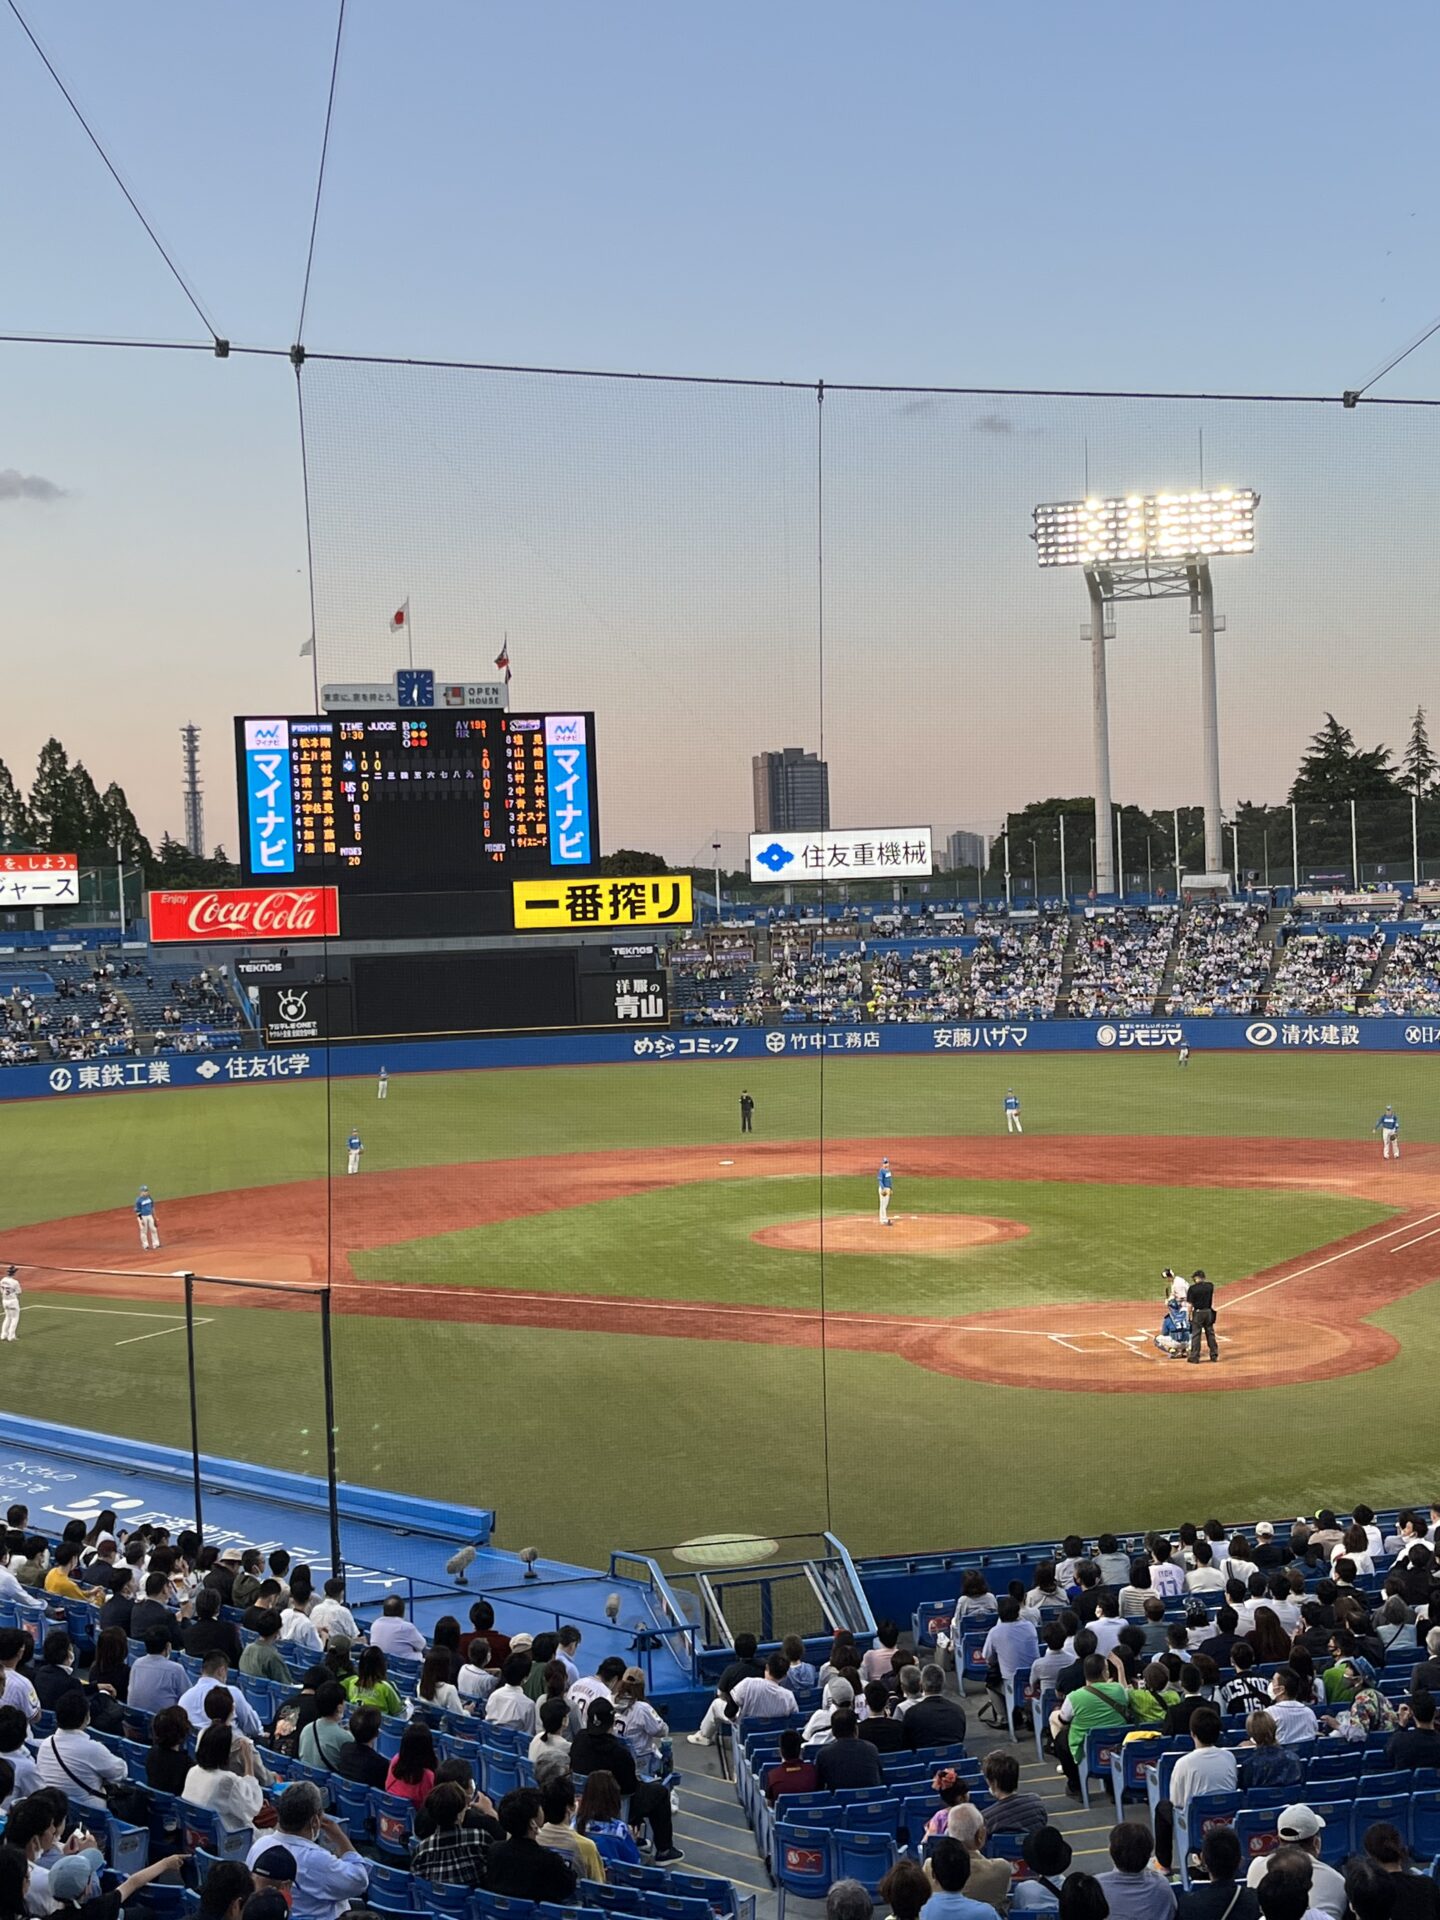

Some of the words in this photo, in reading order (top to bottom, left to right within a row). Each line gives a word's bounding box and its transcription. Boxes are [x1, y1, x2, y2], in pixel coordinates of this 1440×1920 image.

[468, 688, 499, 696] OPEN
[469, 697, 499, 705] HOUSE
[340, 722, 364, 731] TIME
[367, 722, 397, 731] JUDGE
[402, 721, 411, 730] B
[340, 731, 364, 740] 0:30
[403, 731, 411, 740] S
[253, 755, 287, 867] マイナビ
[553, 749, 585, 859] マイナビ
[516, 811, 546, 822] オスナ
[348, 857, 361, 866] 20
[492, 852, 504, 862] 41
[801, 840, 928, 869] 住友重機械
[161, 894, 188, 905] Enjoy
[524, 882, 683, 922] 一番搾り
[188, 891, 320, 933] Coca-Cola
[615, 979, 660, 994] 洋服の
[614, 994, 664, 1019] 青山
[790, 1032, 881, 1050] 竹中工務店
[933, 1025, 1028, 1048] 安藤ハザマ
[1118, 1029, 1182, 1047] シモジマ
[1281, 1023, 1360, 1046] 清水建設
[633, 1035, 739, 1057] めちゃコミック
[77, 1060, 171, 1089] 東鉄工業
[224, 1053, 311, 1080] 住友化学
[1158, 1579, 1178, 1597] 17
